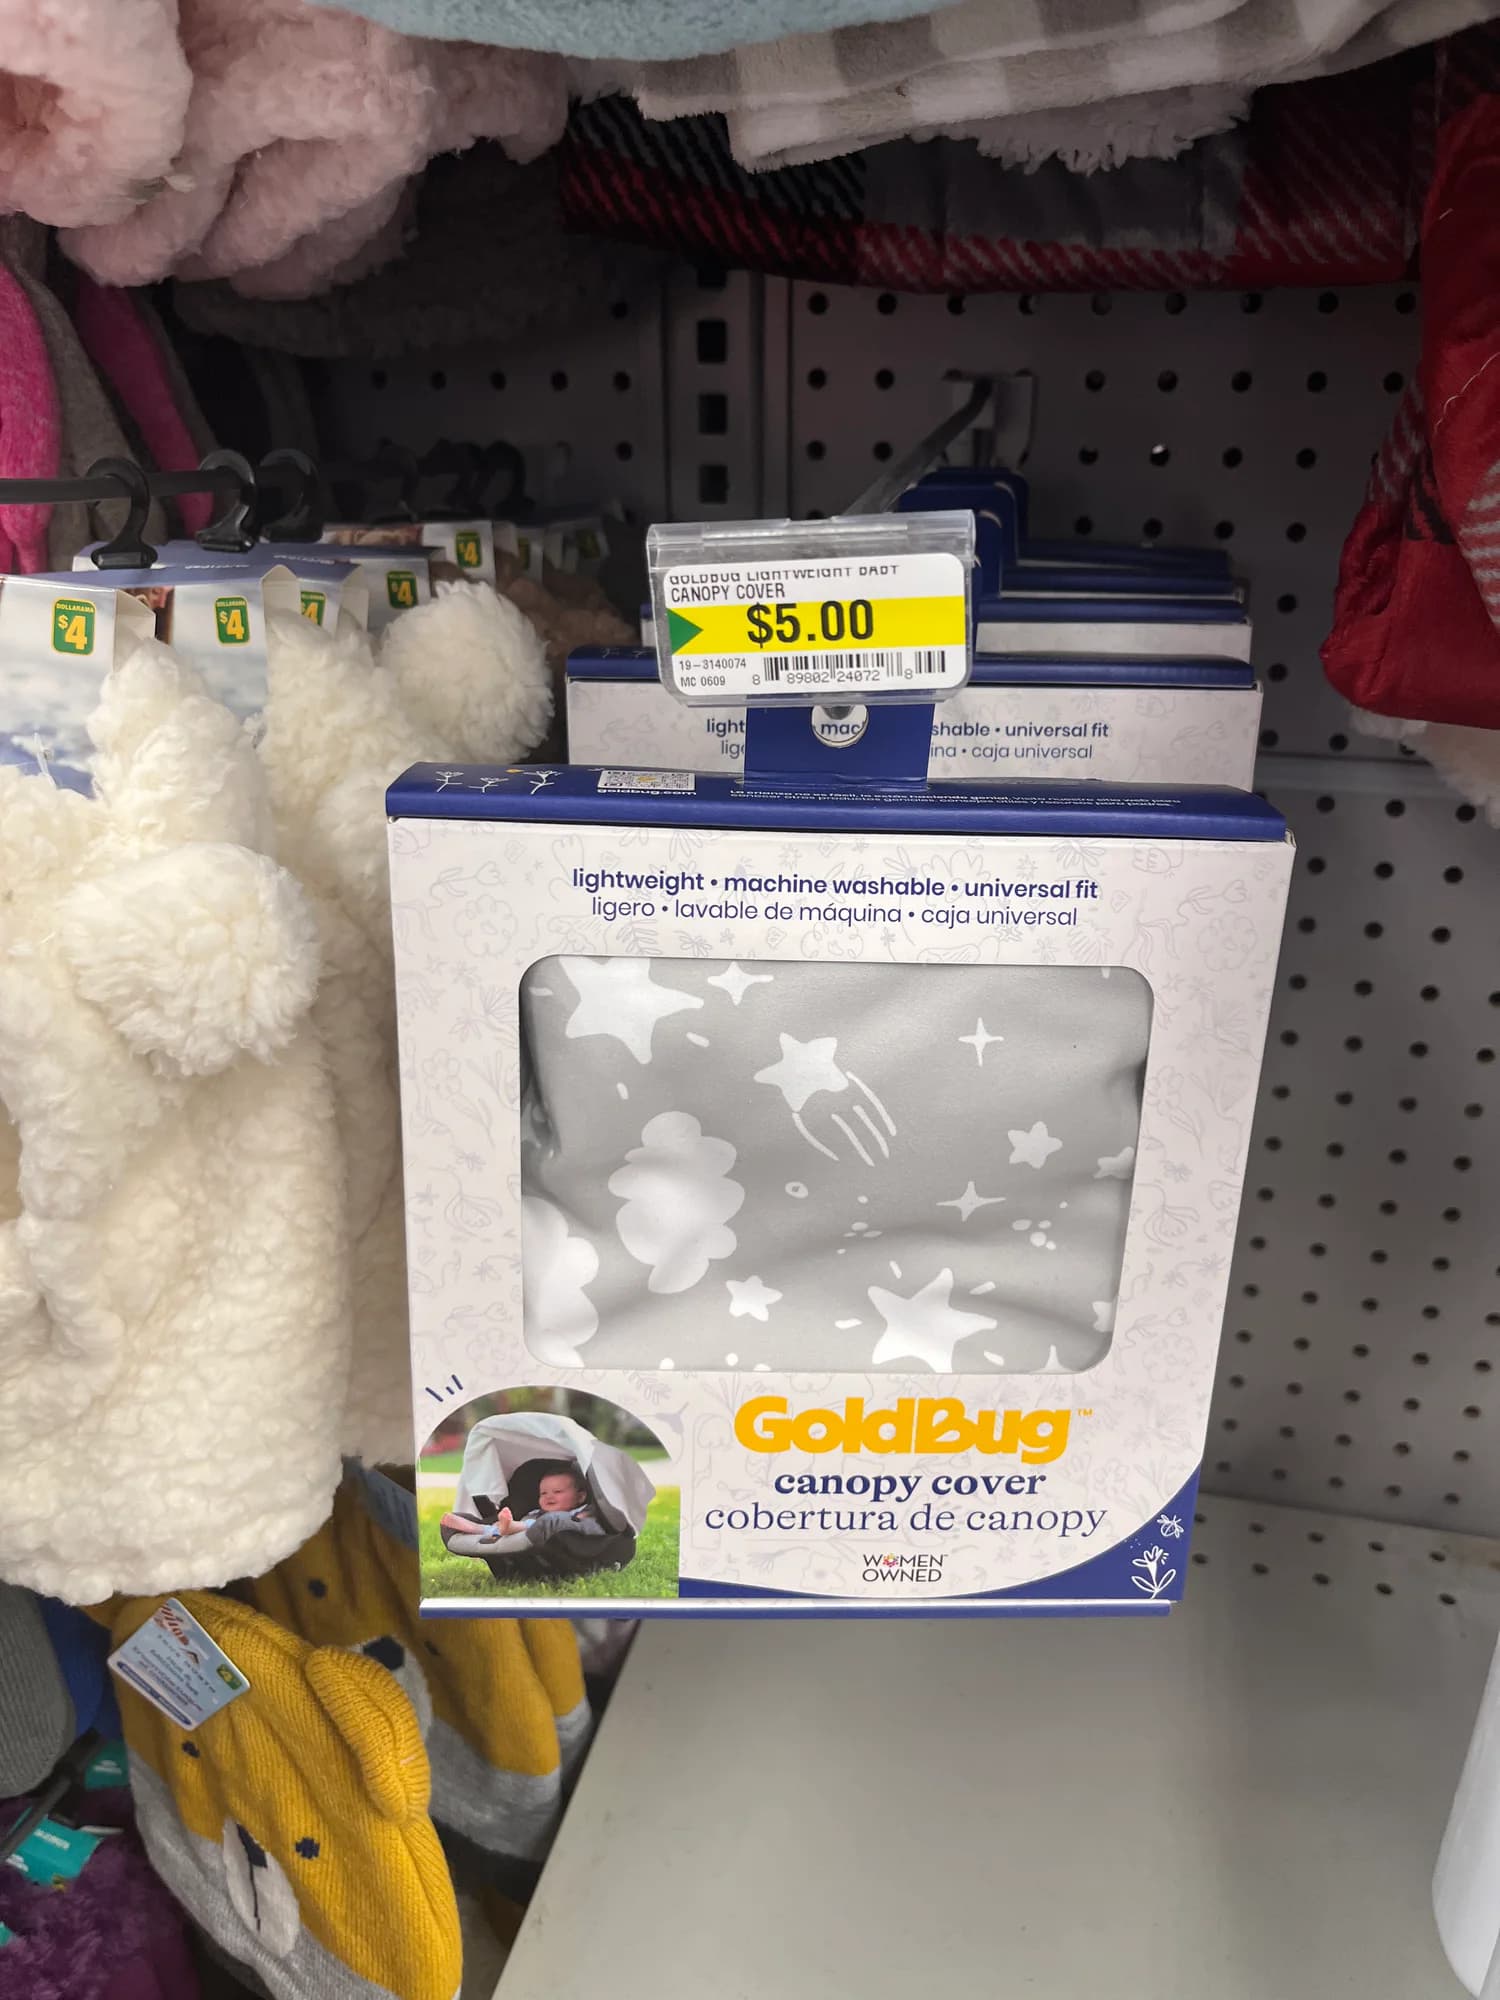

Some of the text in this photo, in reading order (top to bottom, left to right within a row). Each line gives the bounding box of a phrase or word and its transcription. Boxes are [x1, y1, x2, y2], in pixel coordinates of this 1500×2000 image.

[671, 583, 785, 602] CANOPY COVER
[56, 602, 95, 614] DOLLARAMA
[58, 614, 88, 650] $4
[219, 609, 245, 640] $4
[746, 599, 874, 648] $5.00
[681, 676, 726, 687] MC 0609
[752, 668, 913, 685] 8 89802 24072 8
[821, 721, 866, 735] mac
[1005, 722, 1087, 738] universal
[1092, 722, 1109, 737] fit
[971, 744, 1007, 762] caja
[1014, 744, 1093, 760] universal
[597, 788, 697, 796] goldbug.com
[572, 868, 1099, 899] lightweight machine washable universal fit
[592, 896, 1078, 930] ligero lavable de máquina caja universal
[774, 1473, 1047, 1502] canopy cover
[704, 1502, 1108, 1538] cobertura de canopy
[862, 1568, 943, 1583] OWNED
